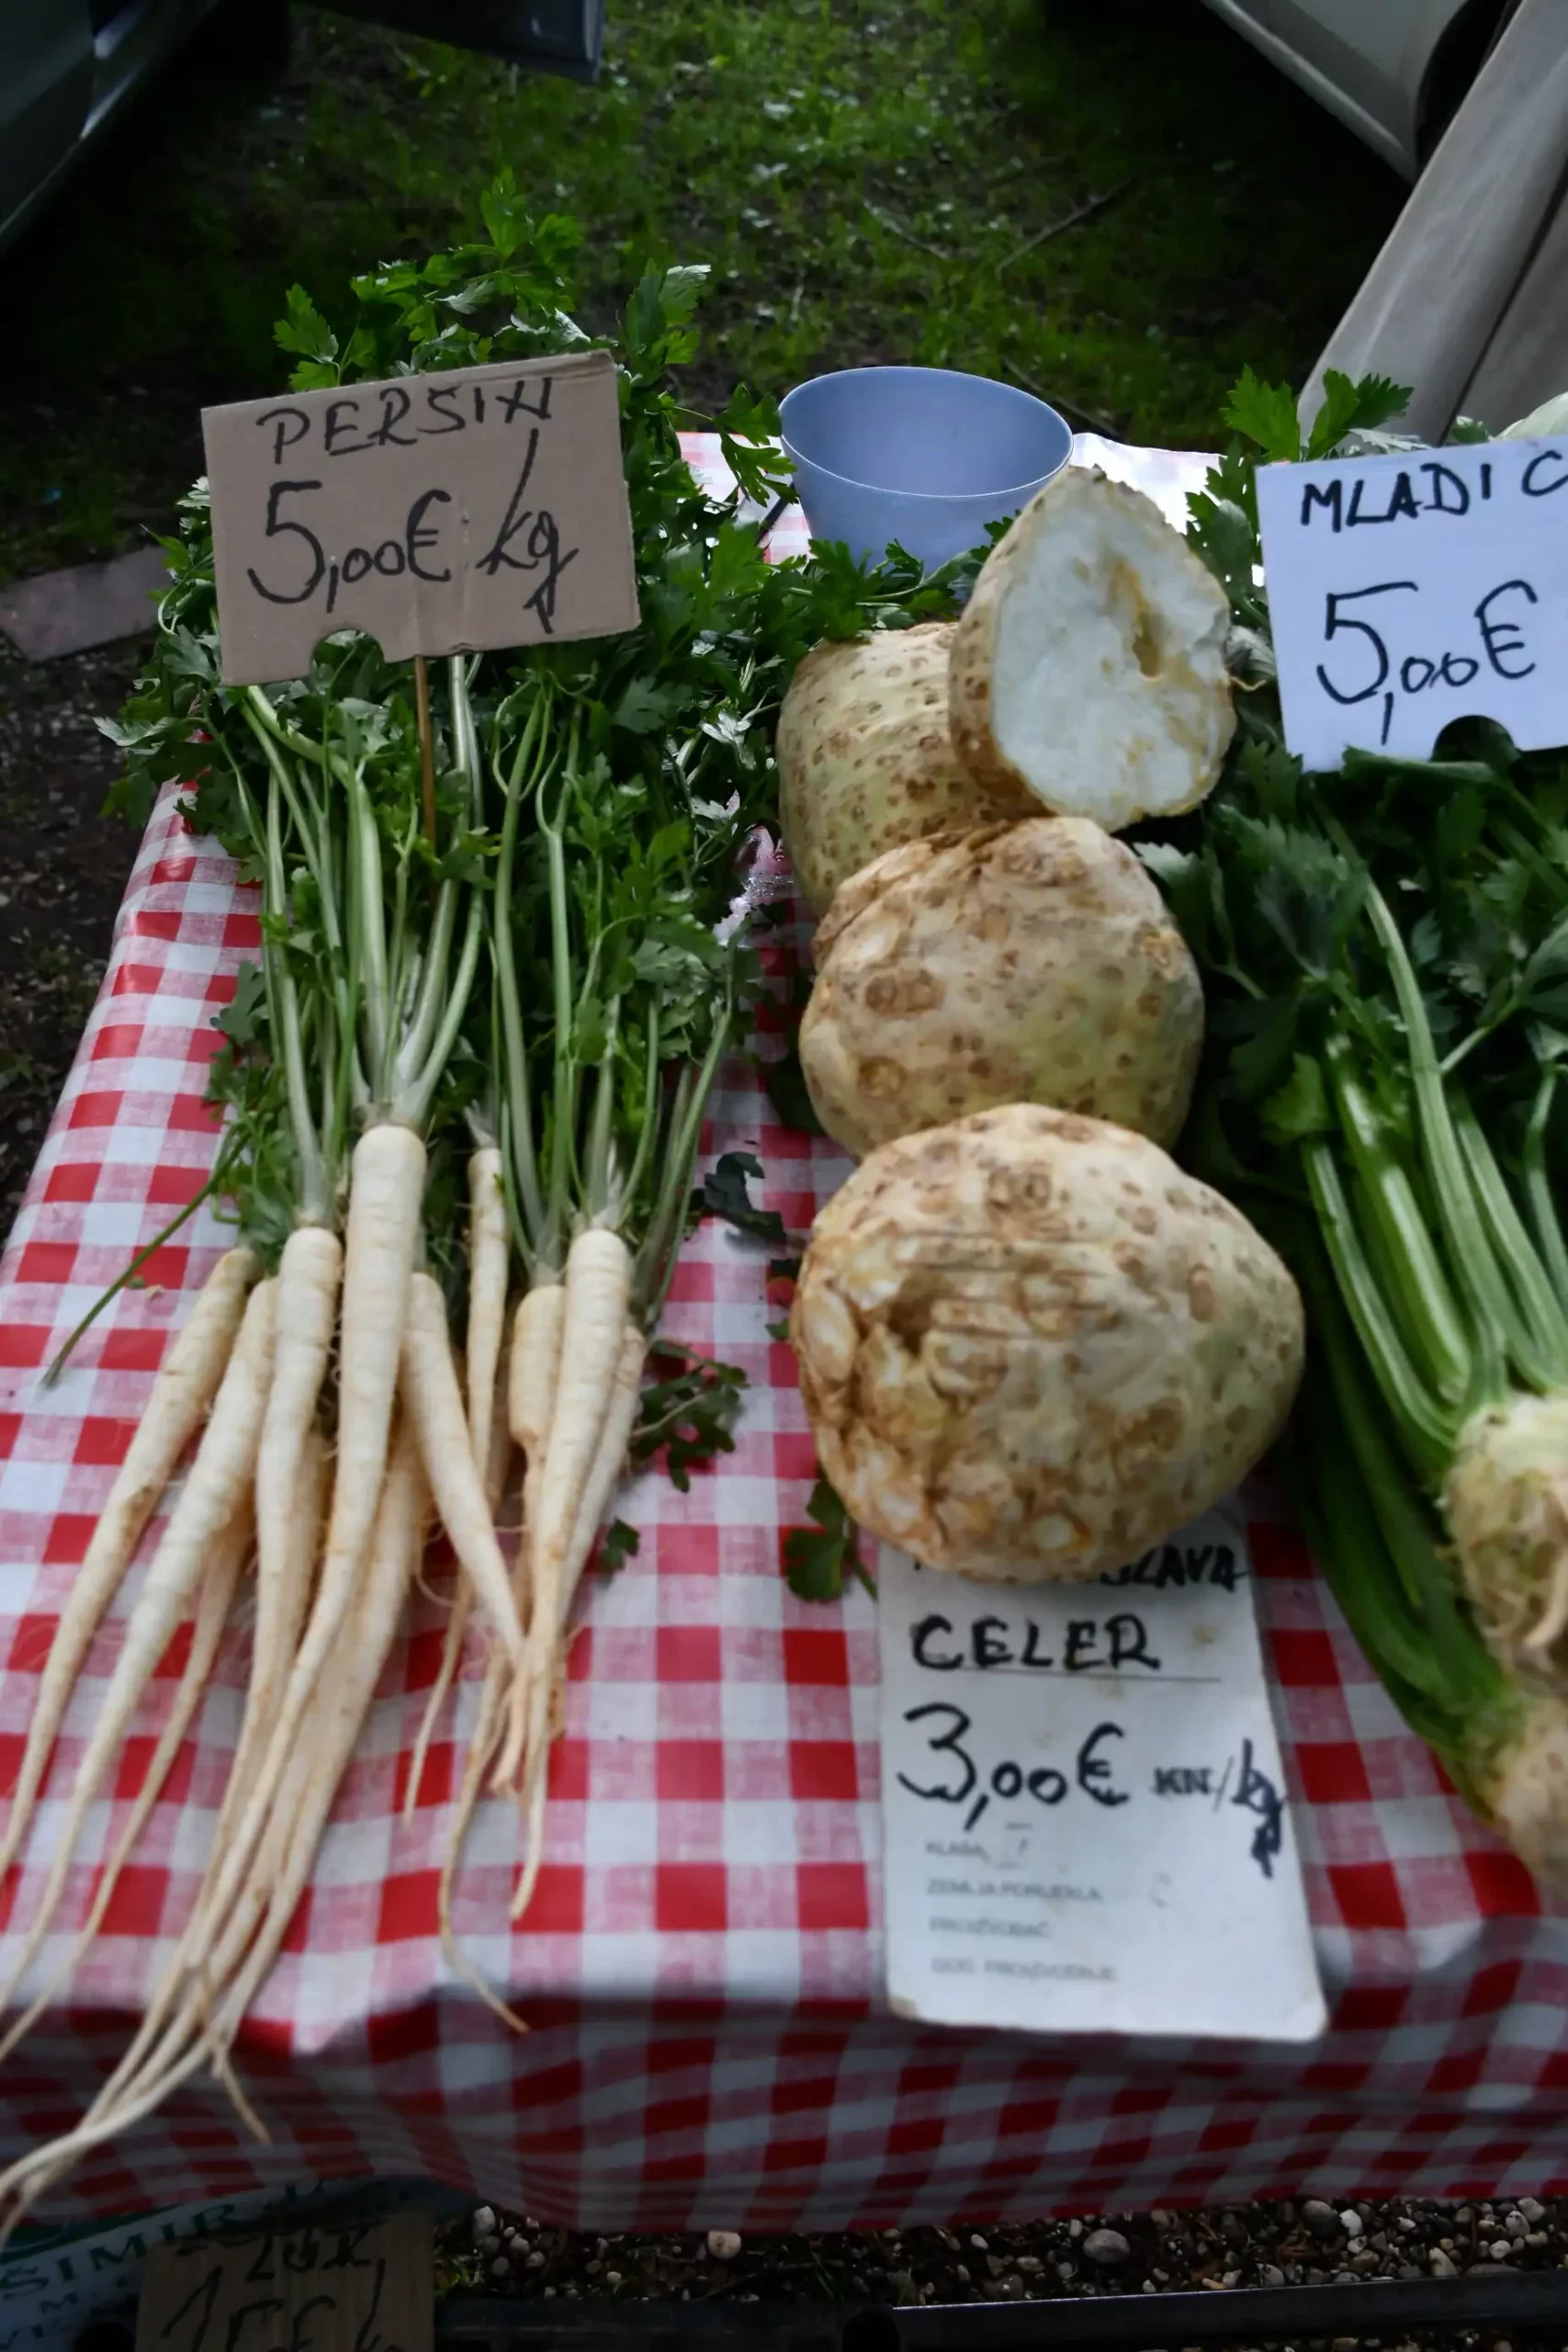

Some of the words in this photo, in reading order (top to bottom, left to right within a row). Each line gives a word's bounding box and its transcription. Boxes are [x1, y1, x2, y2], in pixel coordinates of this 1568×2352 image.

[248, 480, 451, 613] 5,00€
[1301, 463, 1492, 534] MLADI
[1316, 579, 1538, 746] 5,00€
[910, 1614, 1161, 1671] CELER
[897, 1702, 1130, 1831] 3,00€
